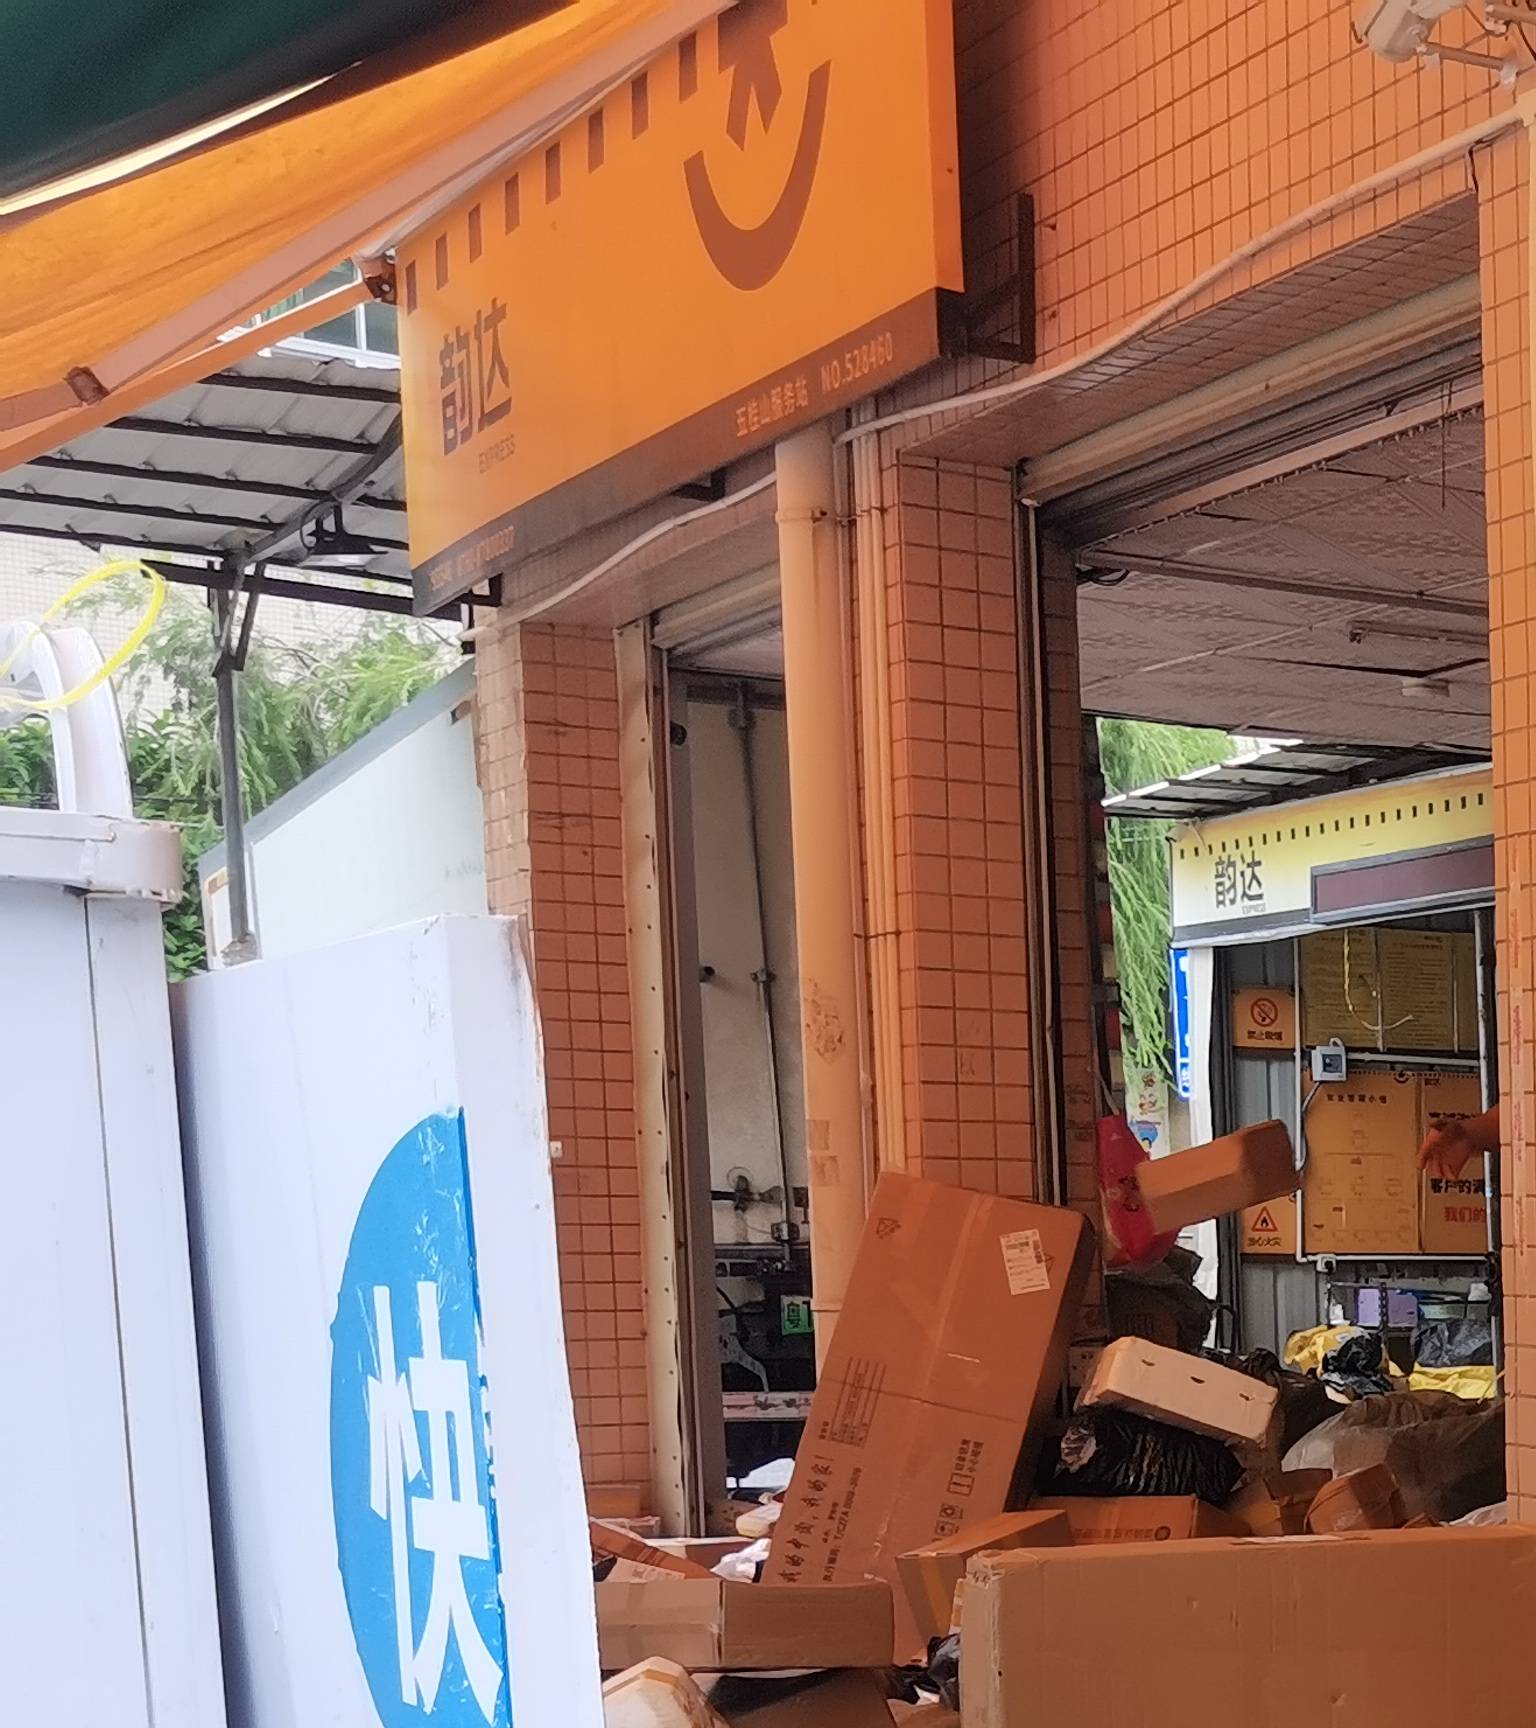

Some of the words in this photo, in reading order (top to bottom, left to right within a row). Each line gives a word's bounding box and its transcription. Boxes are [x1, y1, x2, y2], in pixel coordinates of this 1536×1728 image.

[440, 297, 513, 456] 韵达
[1214, 850, 1265, 908] 韵达
[366, 1281, 506, 1728] 快
